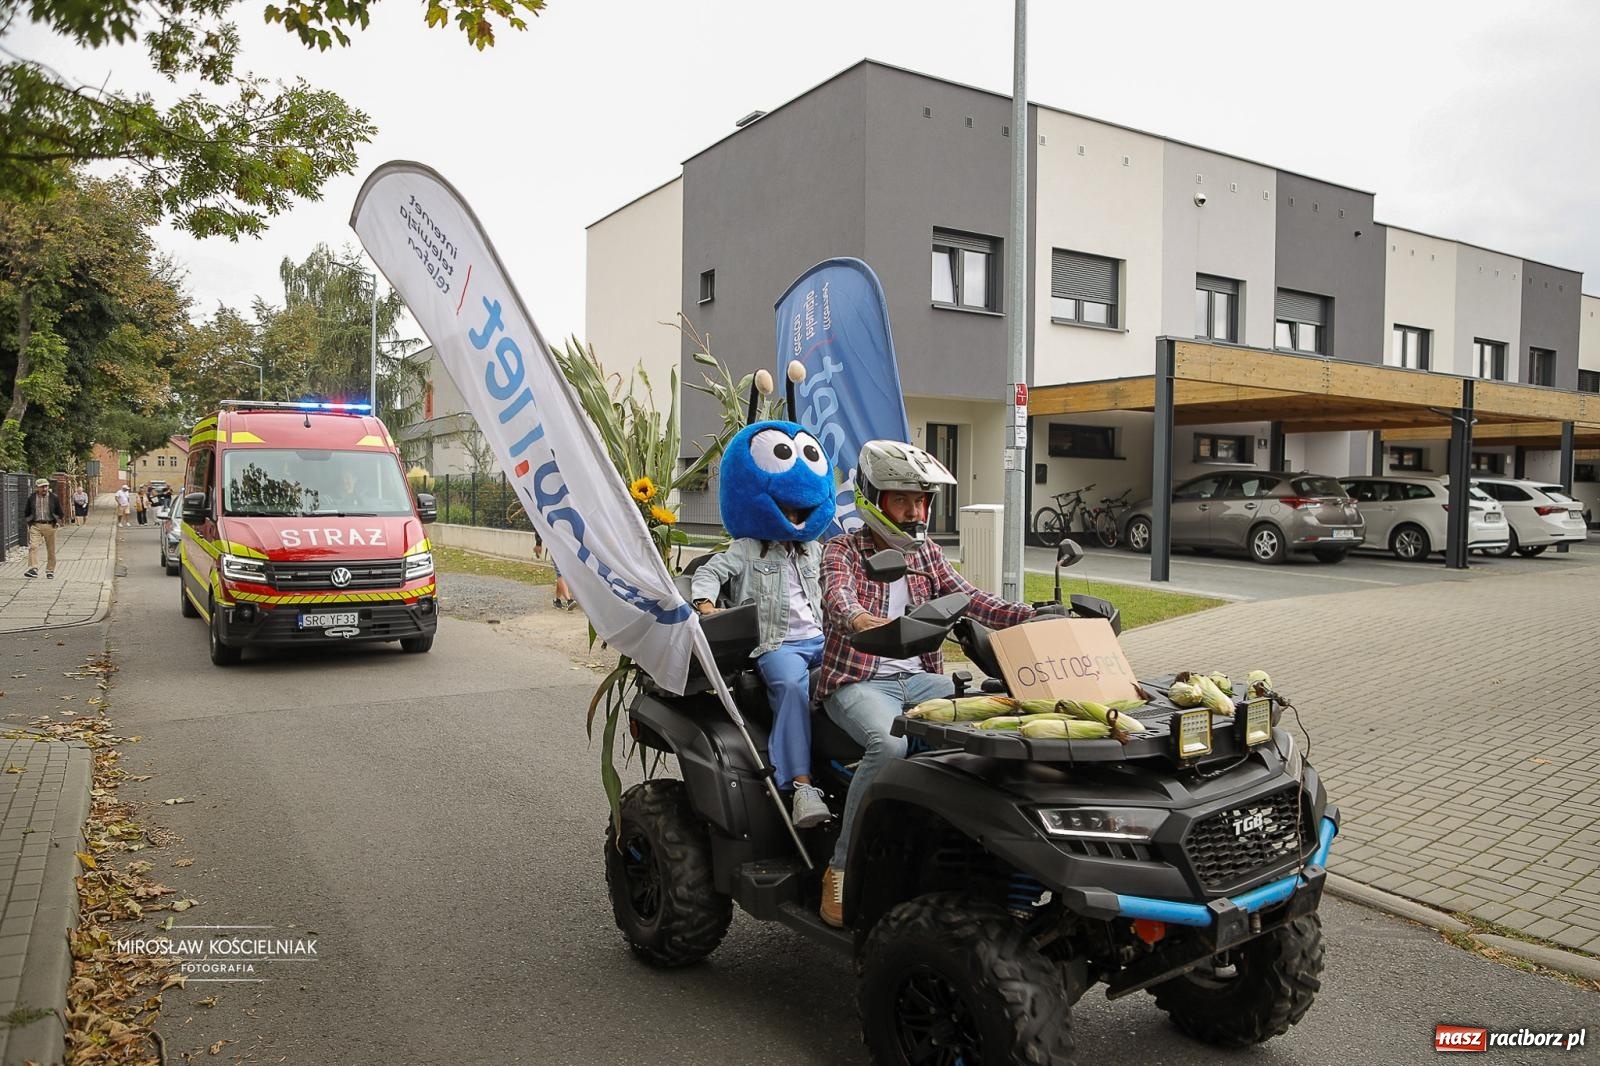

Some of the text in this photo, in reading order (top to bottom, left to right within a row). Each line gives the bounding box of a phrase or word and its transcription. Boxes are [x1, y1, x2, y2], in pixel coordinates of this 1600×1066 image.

[305, 615, 326, 626] SRC
[329, 614, 356, 625] YF33
[1232, 812, 1263, 836] TGB
